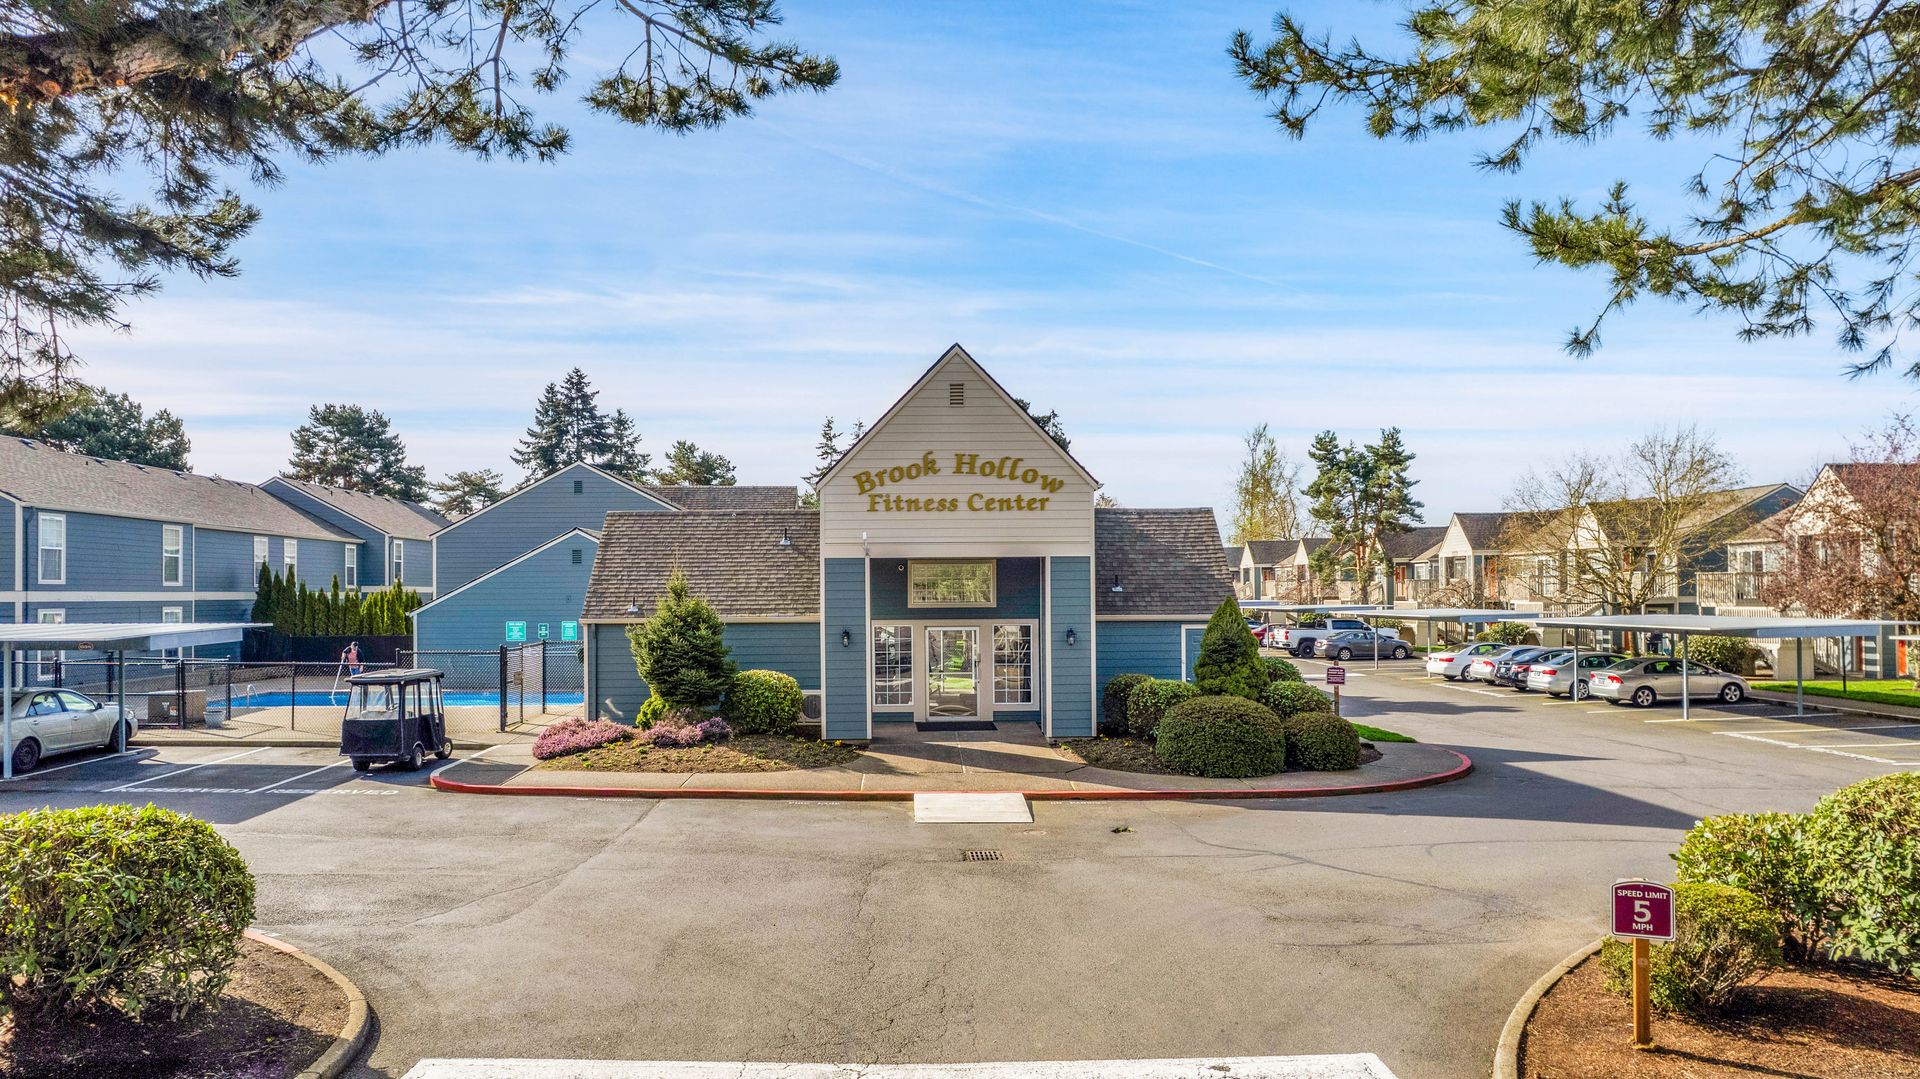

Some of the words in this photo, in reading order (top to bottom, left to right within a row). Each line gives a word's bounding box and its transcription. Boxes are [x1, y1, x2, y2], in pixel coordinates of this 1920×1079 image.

[852, 450, 941, 495] Brook
[952, 453, 1065, 493] Hollow
[866, 493, 959, 512] Fitness
[967, 492, 1050, 512] Center
[1617, 889, 1643, 898] SPEED
[1645, 891, 1668, 900] LIMIT
[1633, 900, 1652, 923] 5
[1632, 922, 1654, 931] MPH
